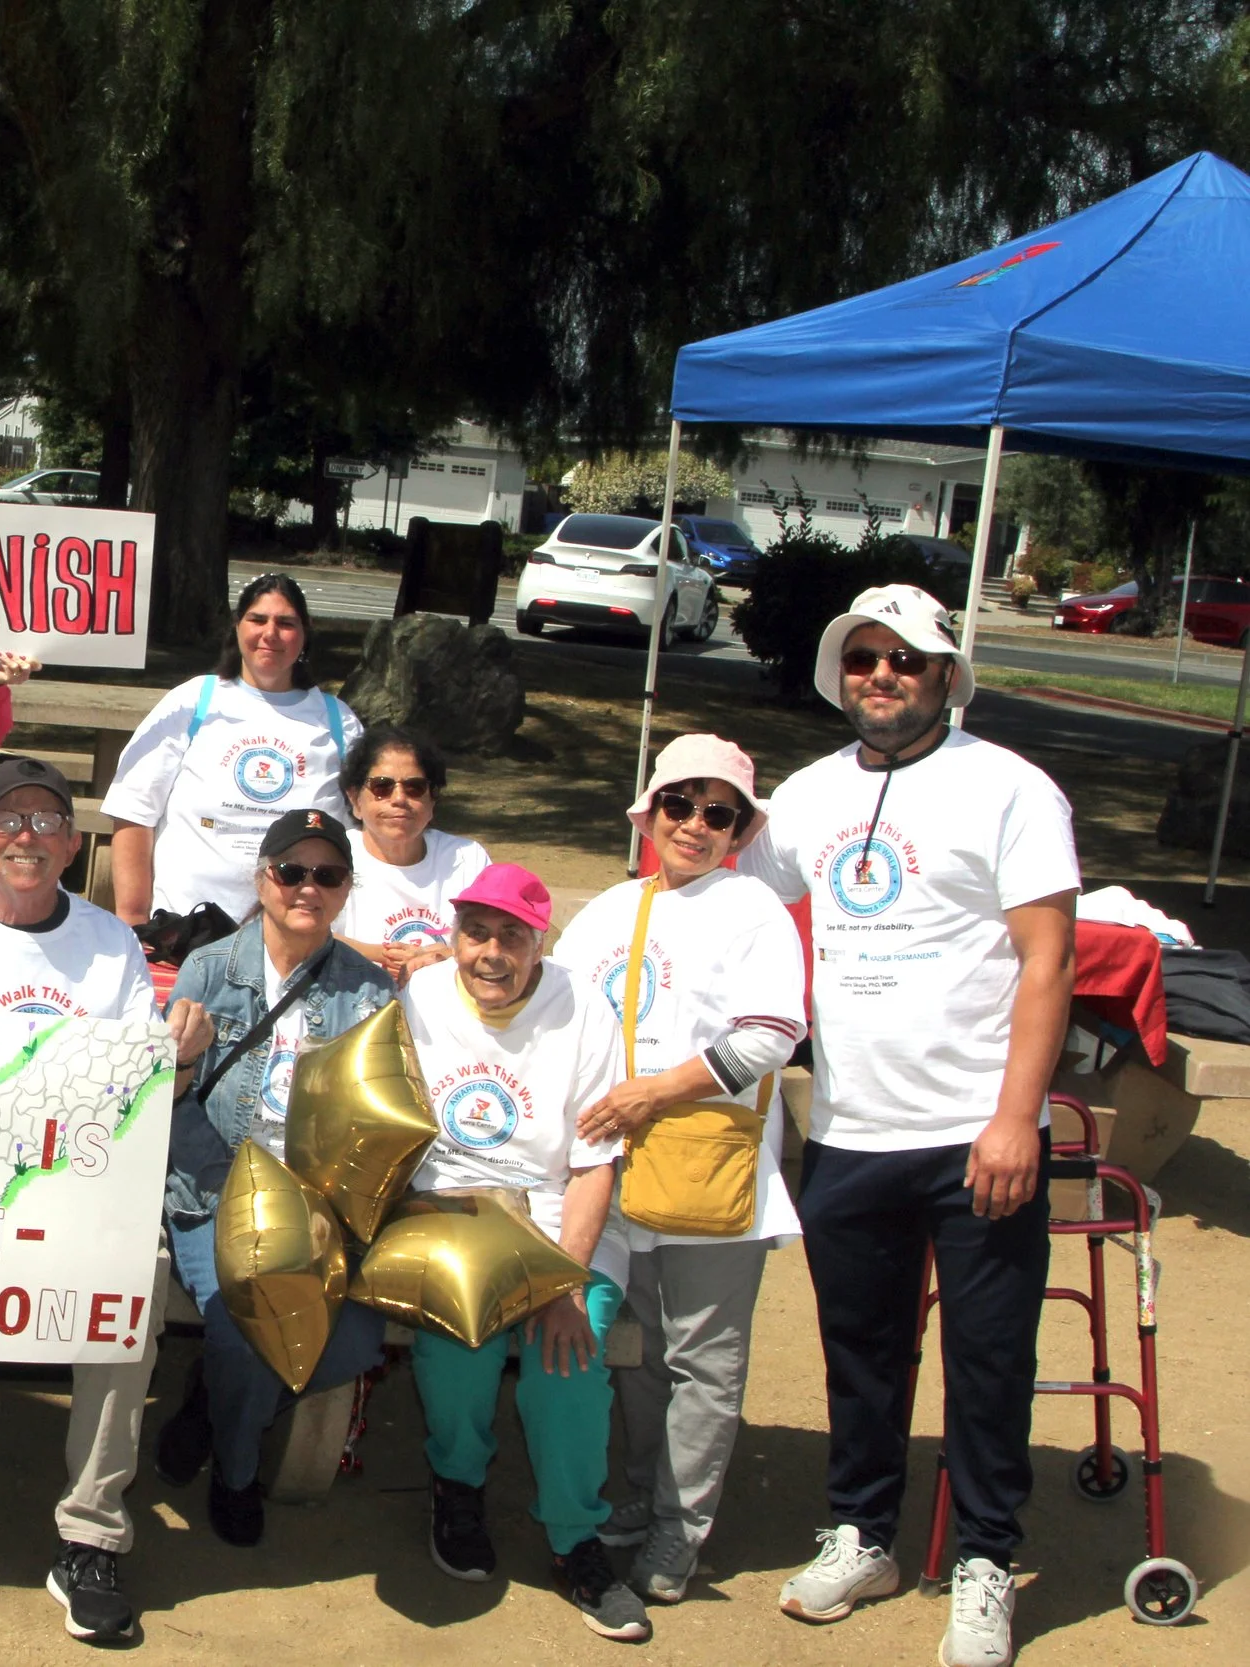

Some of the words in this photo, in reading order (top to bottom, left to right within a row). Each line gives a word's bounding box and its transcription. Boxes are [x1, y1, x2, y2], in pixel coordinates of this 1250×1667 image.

[220, 744, 241, 768] 2025
[240, 736, 268, 747] Walk
[273, 738, 295, 755] This
[295, 752, 307, 779] Way
[221, 801, 234, 809] See
[233, 803, 246, 812] ME,
[257, 807, 268, 815] my
[267, 808, 287, 816] disab
[813, 842, 836, 879] 2025
[836, 820, 872, 842] Walk
[879, 821, 903, 843] This
[902, 840, 921, 876] Way
[833, 842, 882, 874] AWARENSS
[882, 847, 897, 872] WALK
[385, 907, 414, 927] Walk
[418, 908, 440, 925] This
[861, 925, 872, 933] my
[873, 923, 915, 932] disability.
[591, 959, 610, 983] 025
[660, 958, 673, 990] Way
[41, 986, 73, 1009] This
[449, 1082, 500, 1107] AWARENESS
[499, 1092, 515, 1117] WALK
[456, 1062, 491, 1079] Walk
[494, 1064, 519, 1090] This
[518, 1085, 535, 1120] Way
[458, 1118, 476, 1128] Serra
[476, 1121, 498, 1131] Center
[40, 1117, 111, 1177] IS
